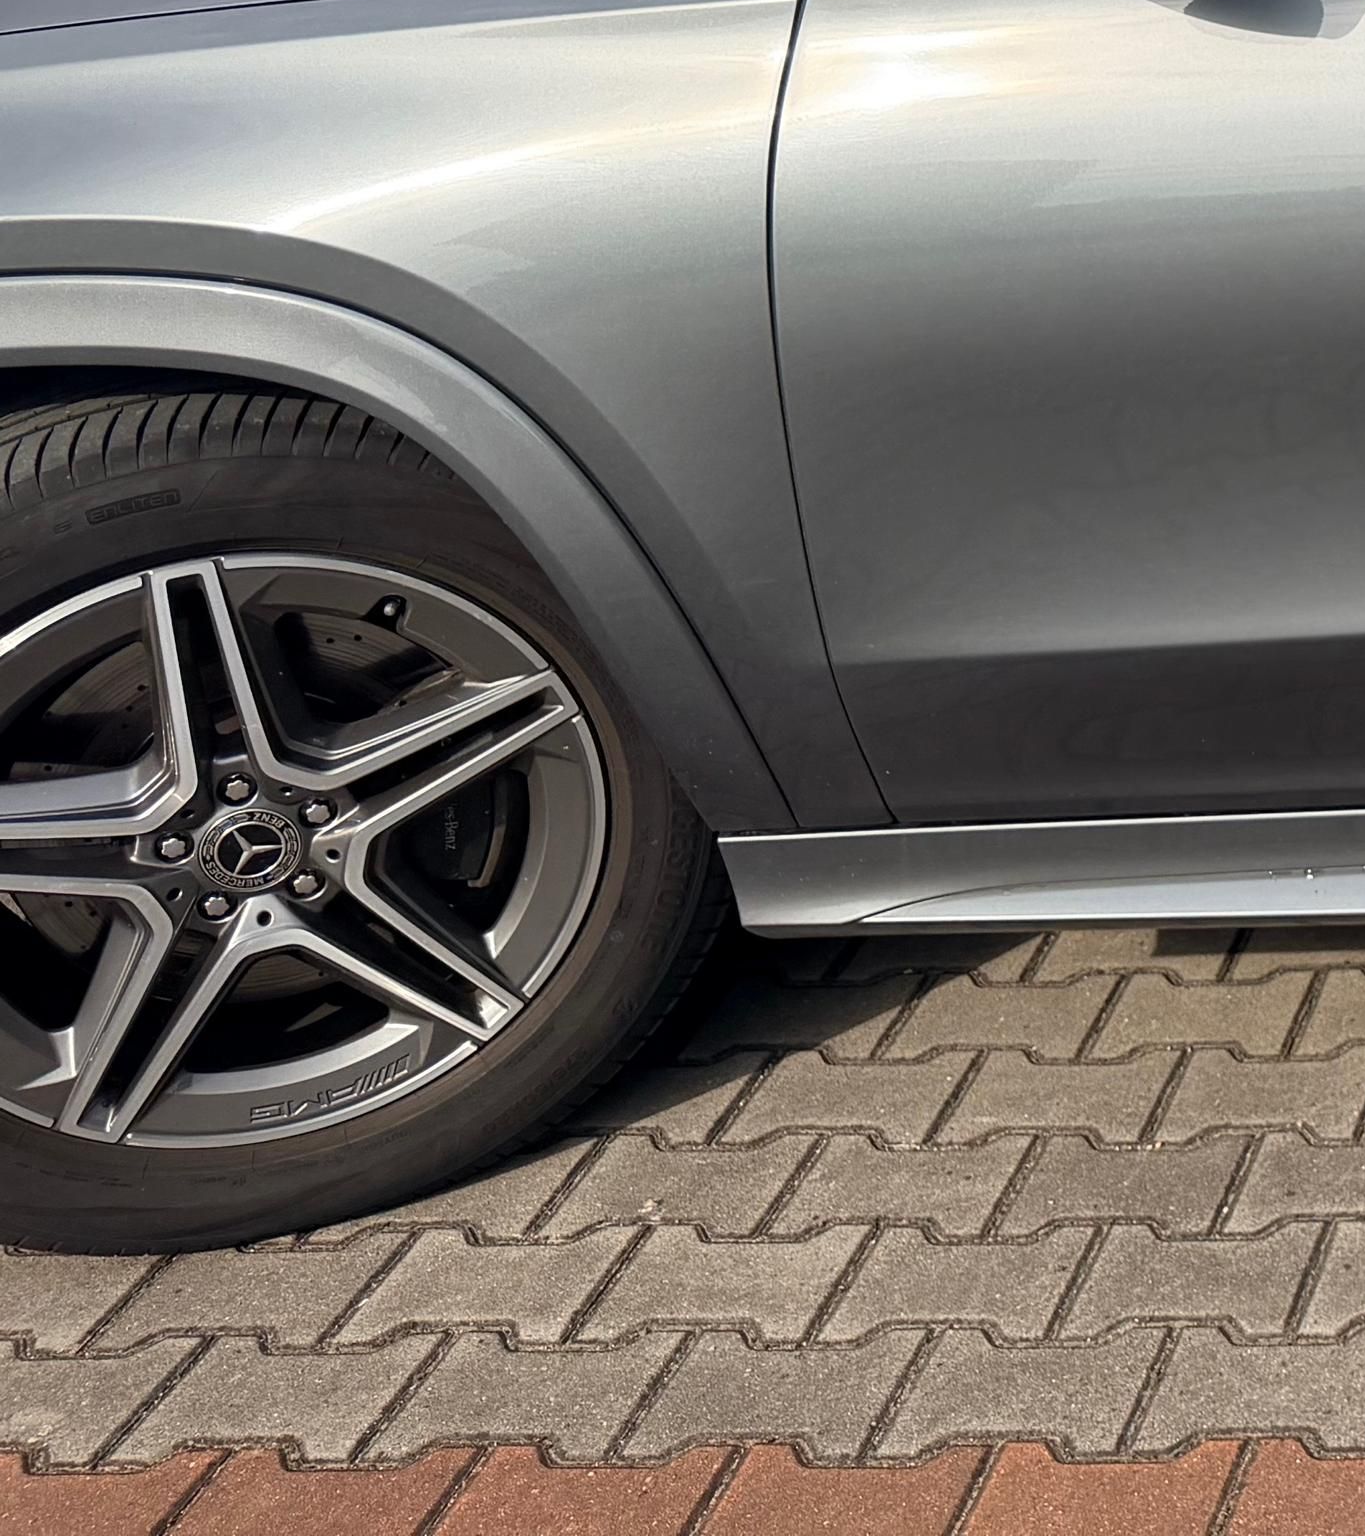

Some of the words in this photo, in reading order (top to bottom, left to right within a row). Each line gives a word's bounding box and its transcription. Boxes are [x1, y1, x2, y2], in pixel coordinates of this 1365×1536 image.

[88, 489, 179, 524] ENLITEN
[252, 812, 287, 829] BENZ
[206, 861, 266, 888] MERCEDES
